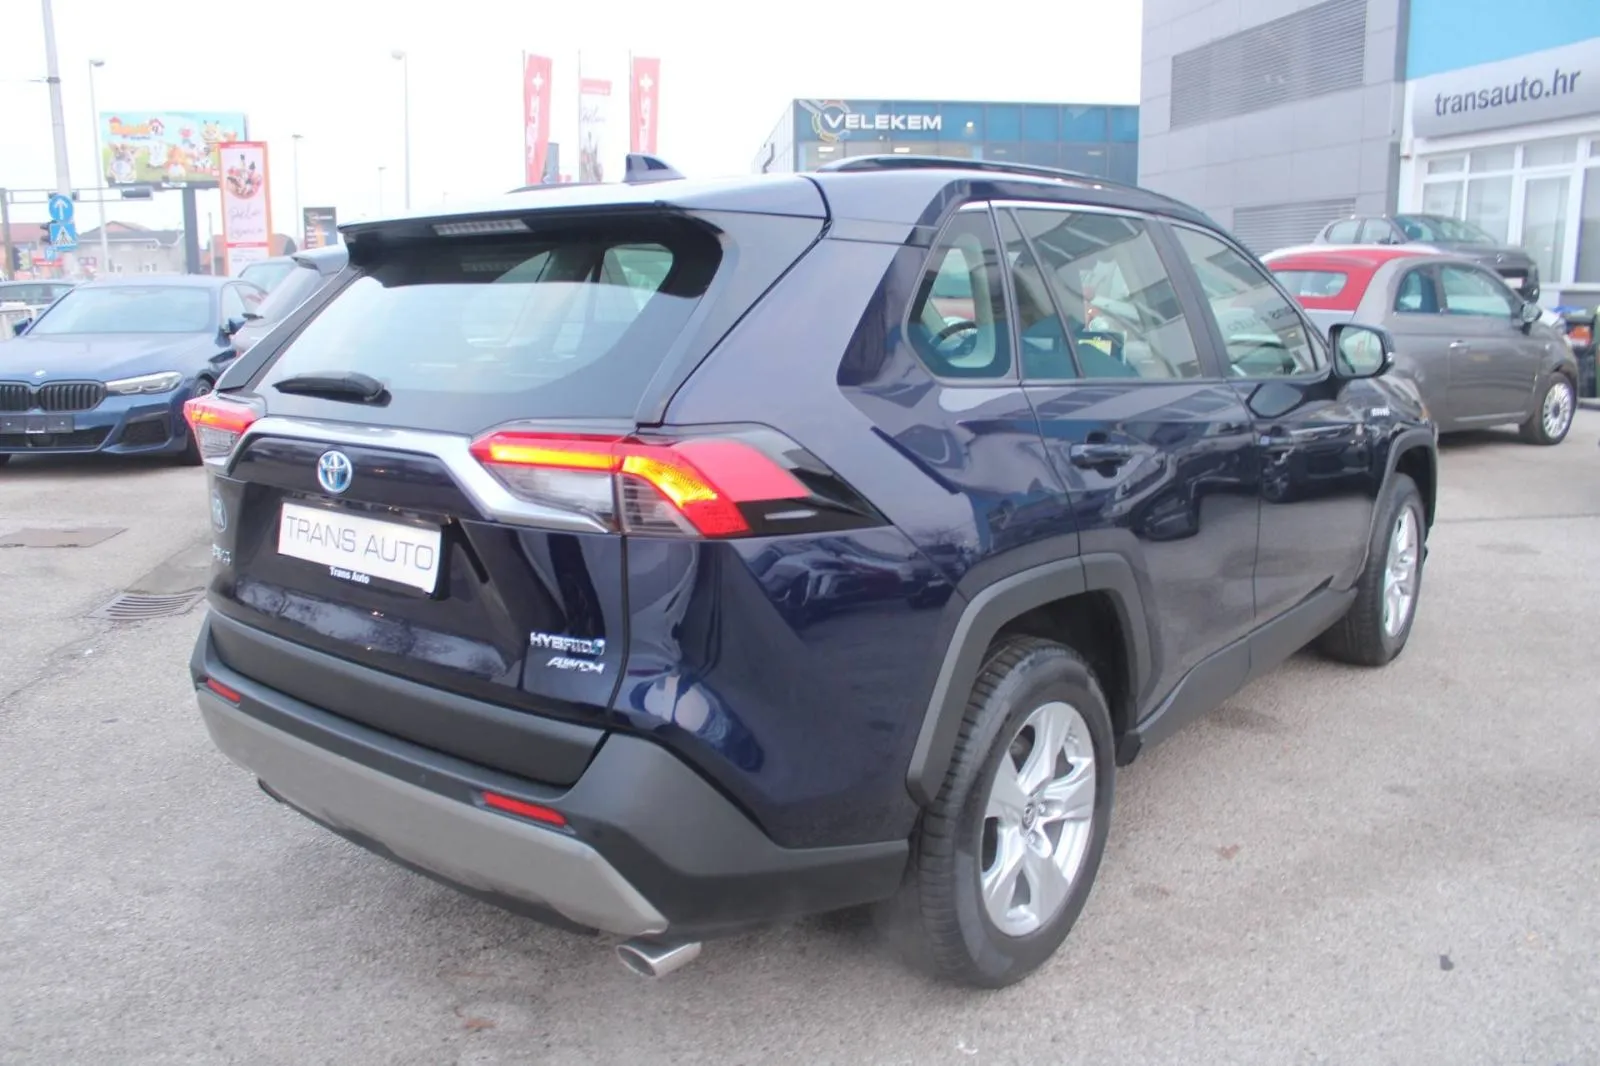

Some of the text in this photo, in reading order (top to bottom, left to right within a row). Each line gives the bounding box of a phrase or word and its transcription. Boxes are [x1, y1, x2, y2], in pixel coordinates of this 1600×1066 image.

[1434, 67, 1581, 117] transauto.hr
[823, 114, 942, 131] VELEKEM
[286, 515, 435, 572] TRANS AUTO
[329, 566, 371, 585] Trans Auto
